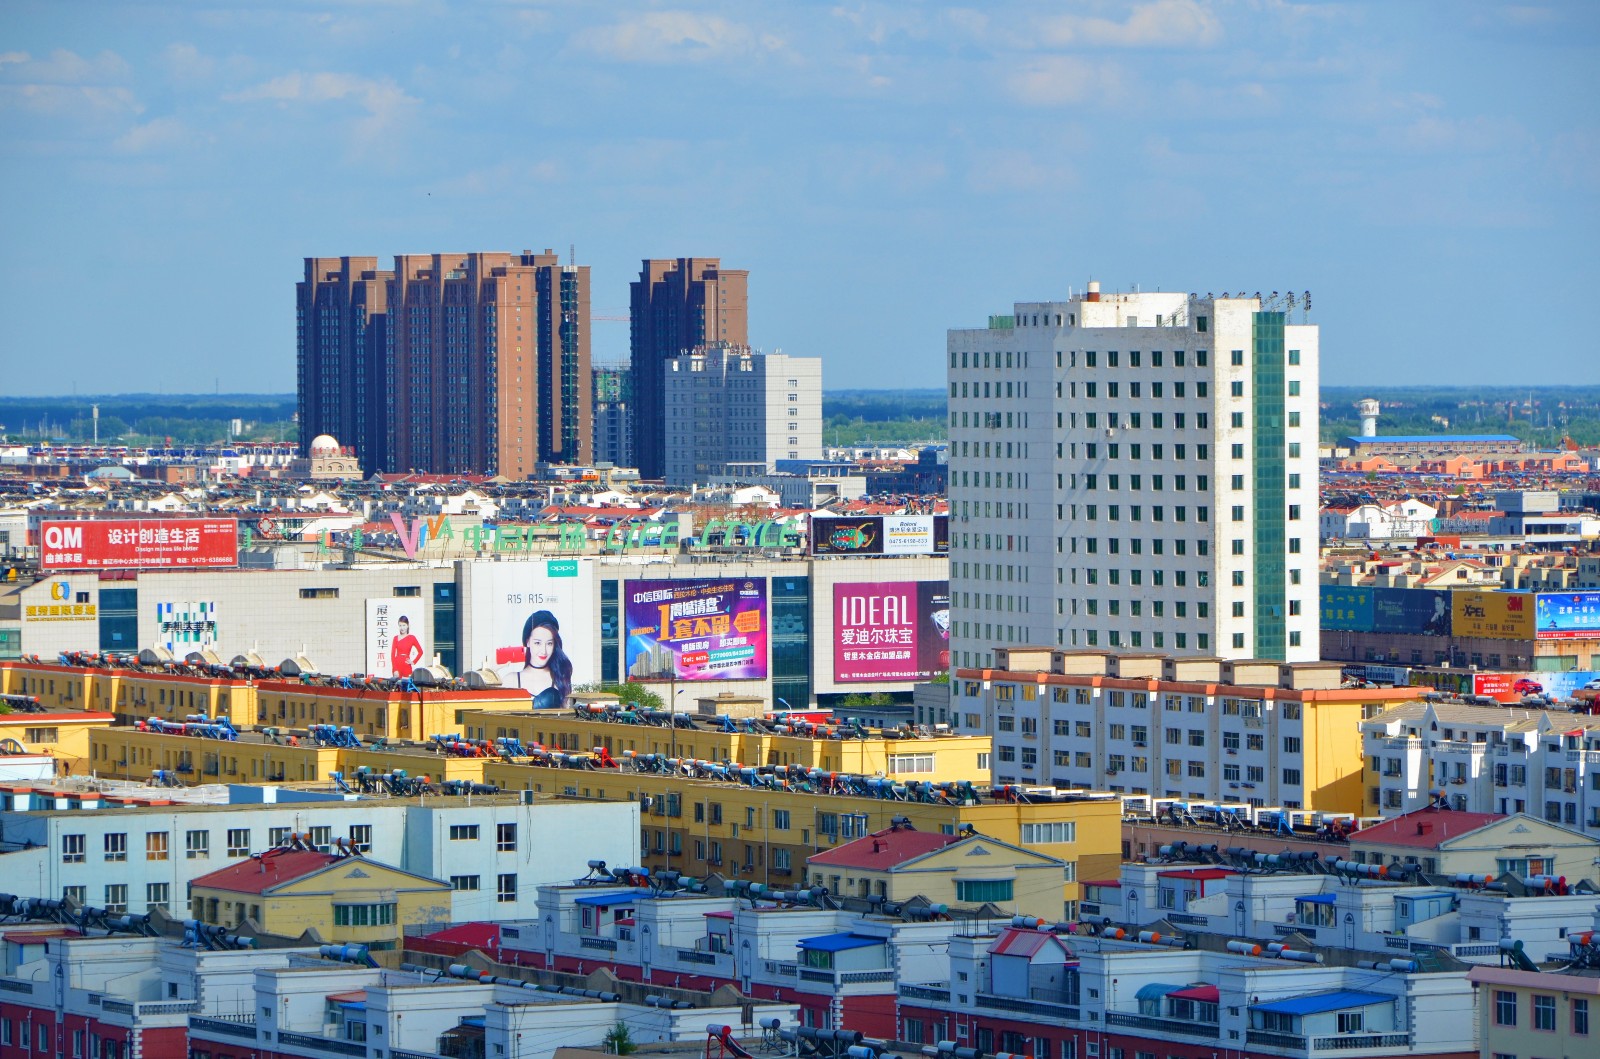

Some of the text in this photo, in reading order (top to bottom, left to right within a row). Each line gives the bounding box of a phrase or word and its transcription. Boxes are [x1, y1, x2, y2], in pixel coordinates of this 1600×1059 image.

[45, 527, 82, 549] QM
[108, 528, 200, 545] 设计创造生活
[607, 520, 798, 549] LIFE STYLE
[45, 553, 82, 563] 曲美家居
[508, 594, 522, 604] R15
[529, 594, 544, 604] R15
[633, 588, 673, 604] 中信国际
[1507, 596, 1523, 612] 3M
[842, 596, 911, 626] IDEAL
[1464, 604, 1486, 618] XPEL
[841, 628, 912, 644] 爱迪尔珠宝
[843, 651, 910, 661] 哲里木金店加盟品牌
